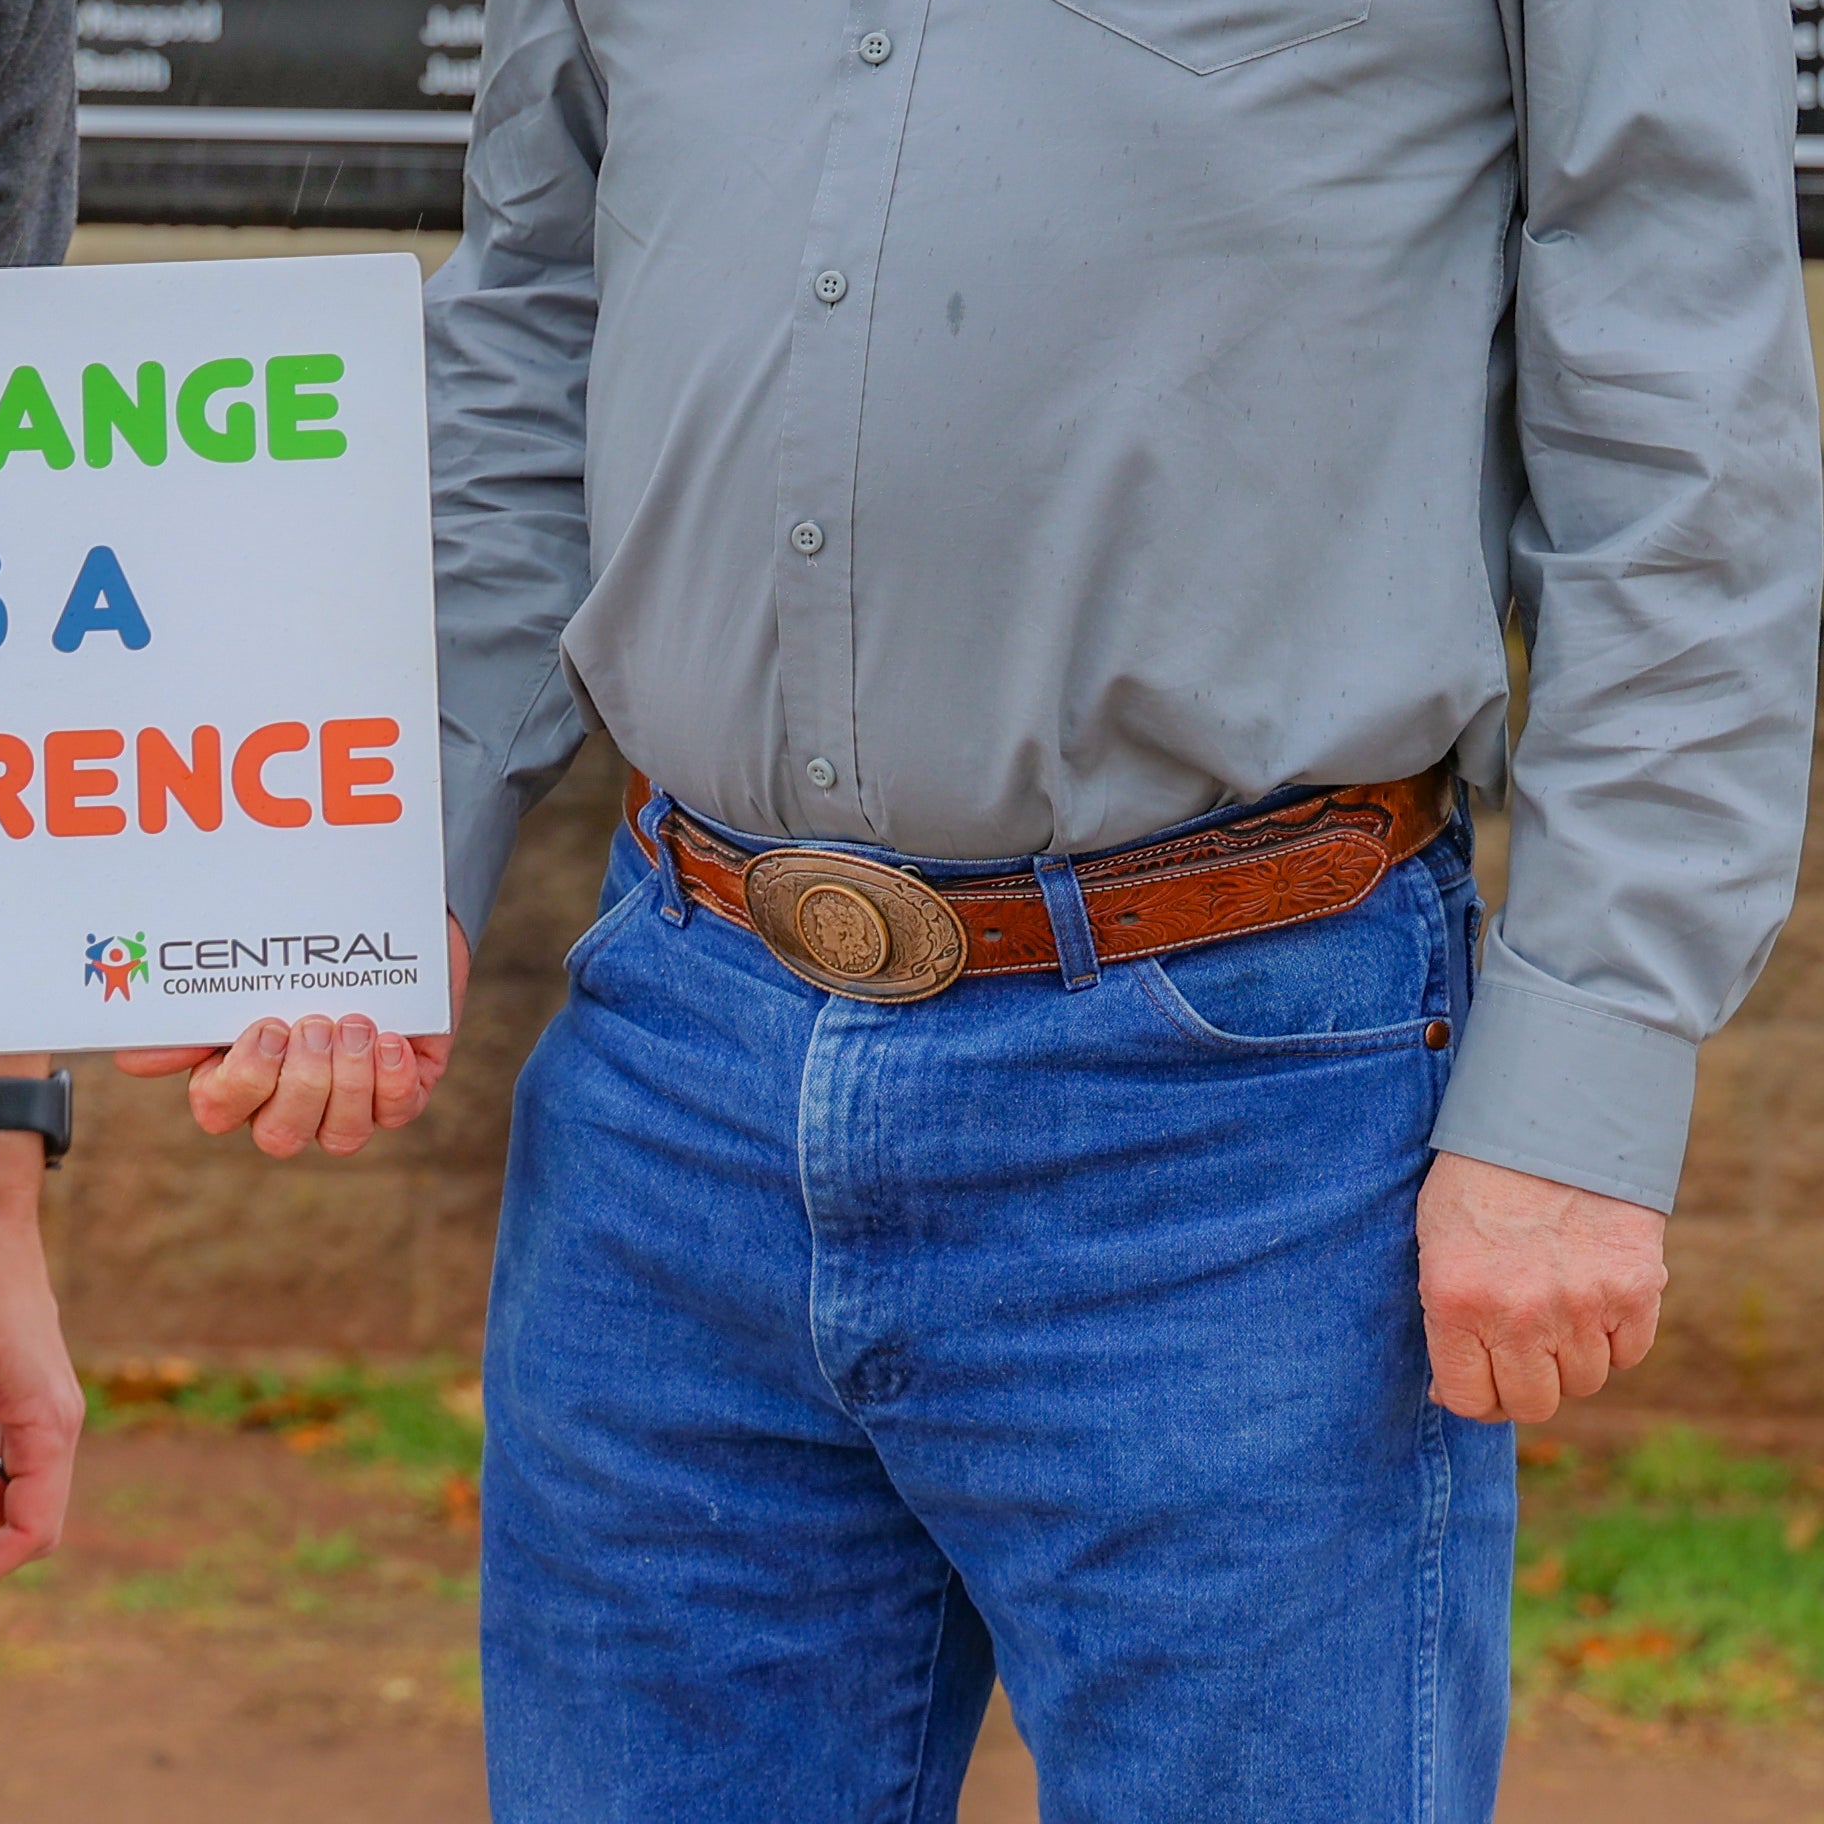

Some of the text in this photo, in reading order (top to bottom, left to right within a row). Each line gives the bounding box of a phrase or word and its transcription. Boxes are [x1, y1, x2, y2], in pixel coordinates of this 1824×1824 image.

[51, 543, 153, 655] A
[158, 931, 419, 972] CENTRAL
[162, 967, 419, 996] COMMUNITY FOUNDATION
